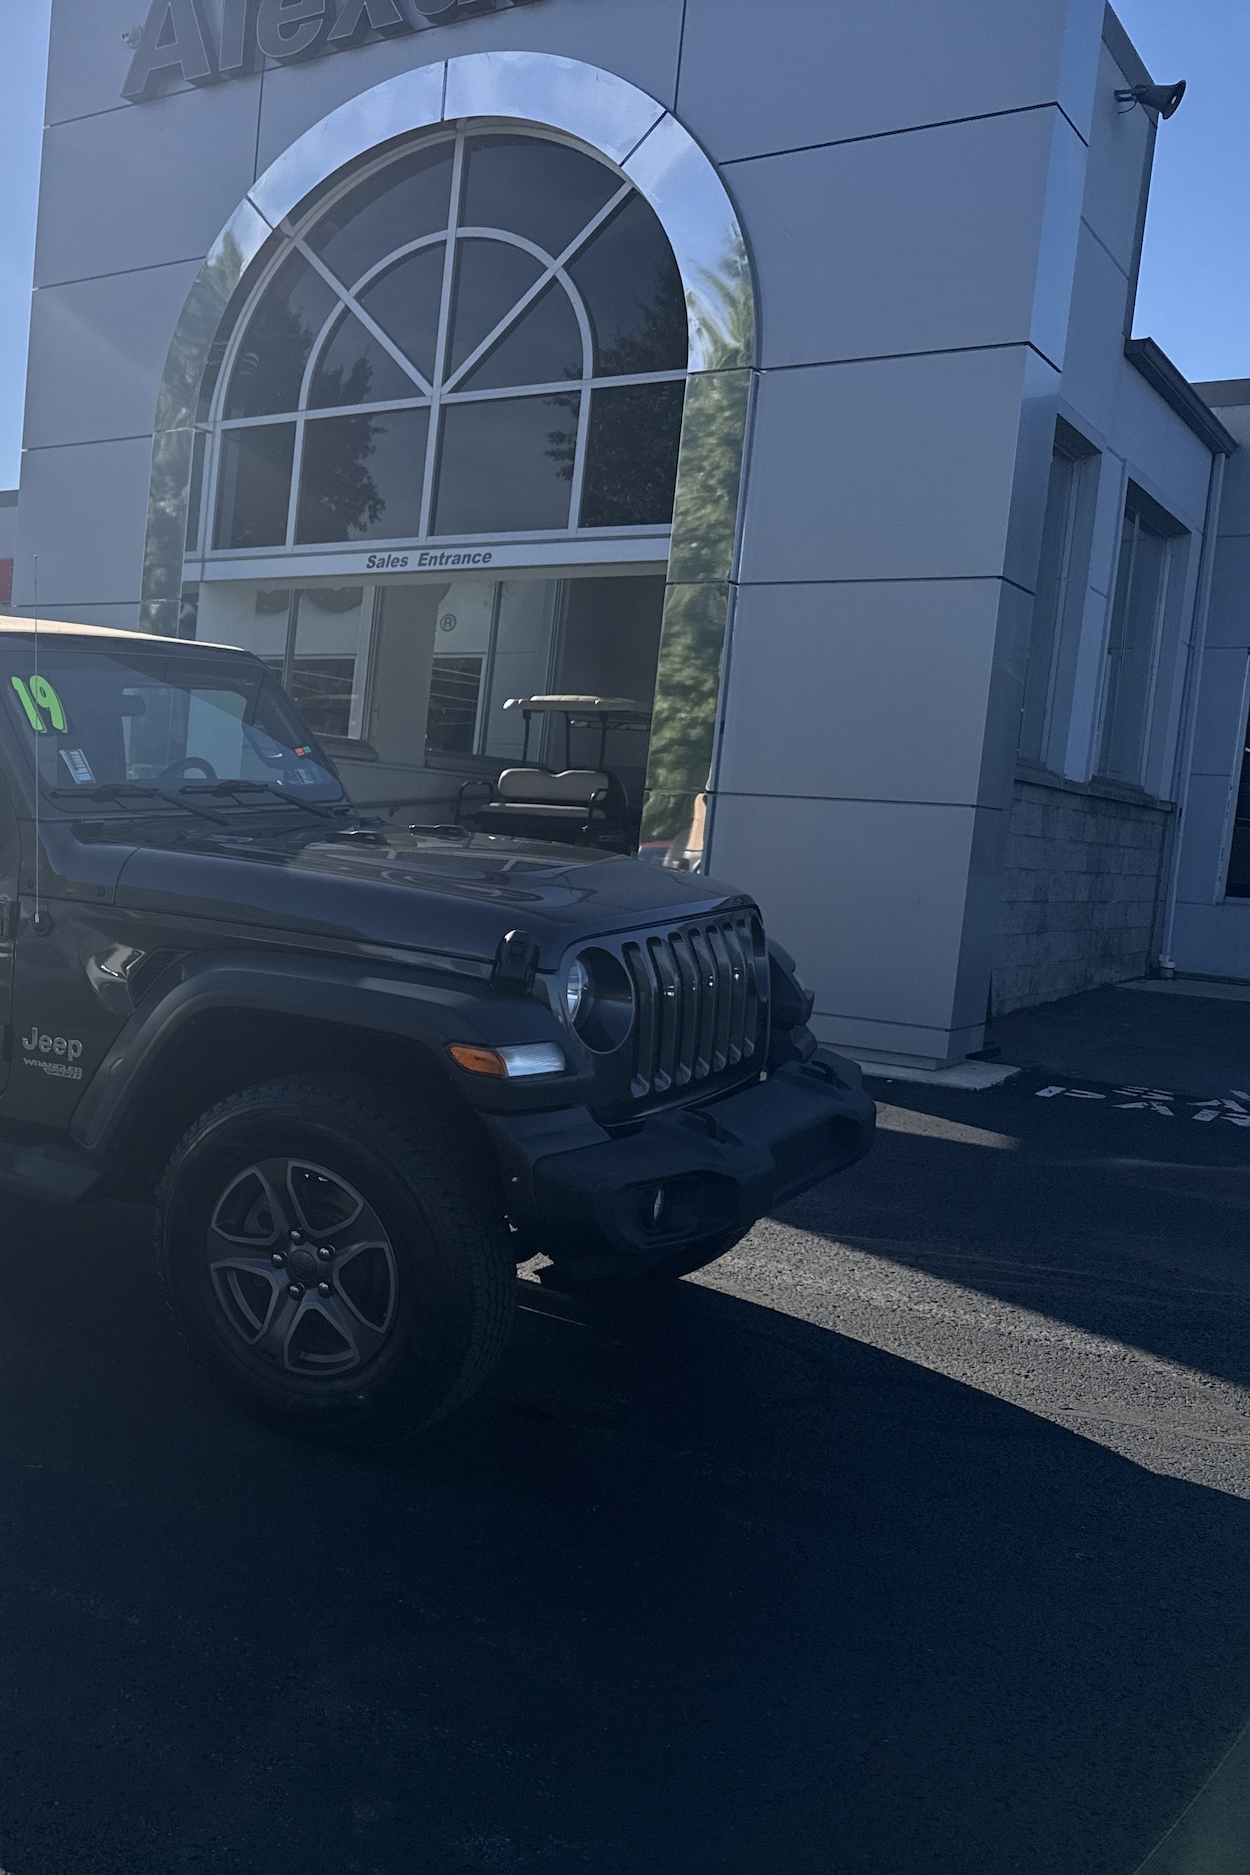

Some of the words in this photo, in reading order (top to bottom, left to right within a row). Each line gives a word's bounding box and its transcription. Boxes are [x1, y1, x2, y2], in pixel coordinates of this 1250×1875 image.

[366, 554, 409, 569] Sales
[417, 551, 493, 567] Entrance
[11, 674, 68, 733] 19
[22, 1027, 83, 1062] Jeep
[23, 1057, 83, 1074] WRANGLER
